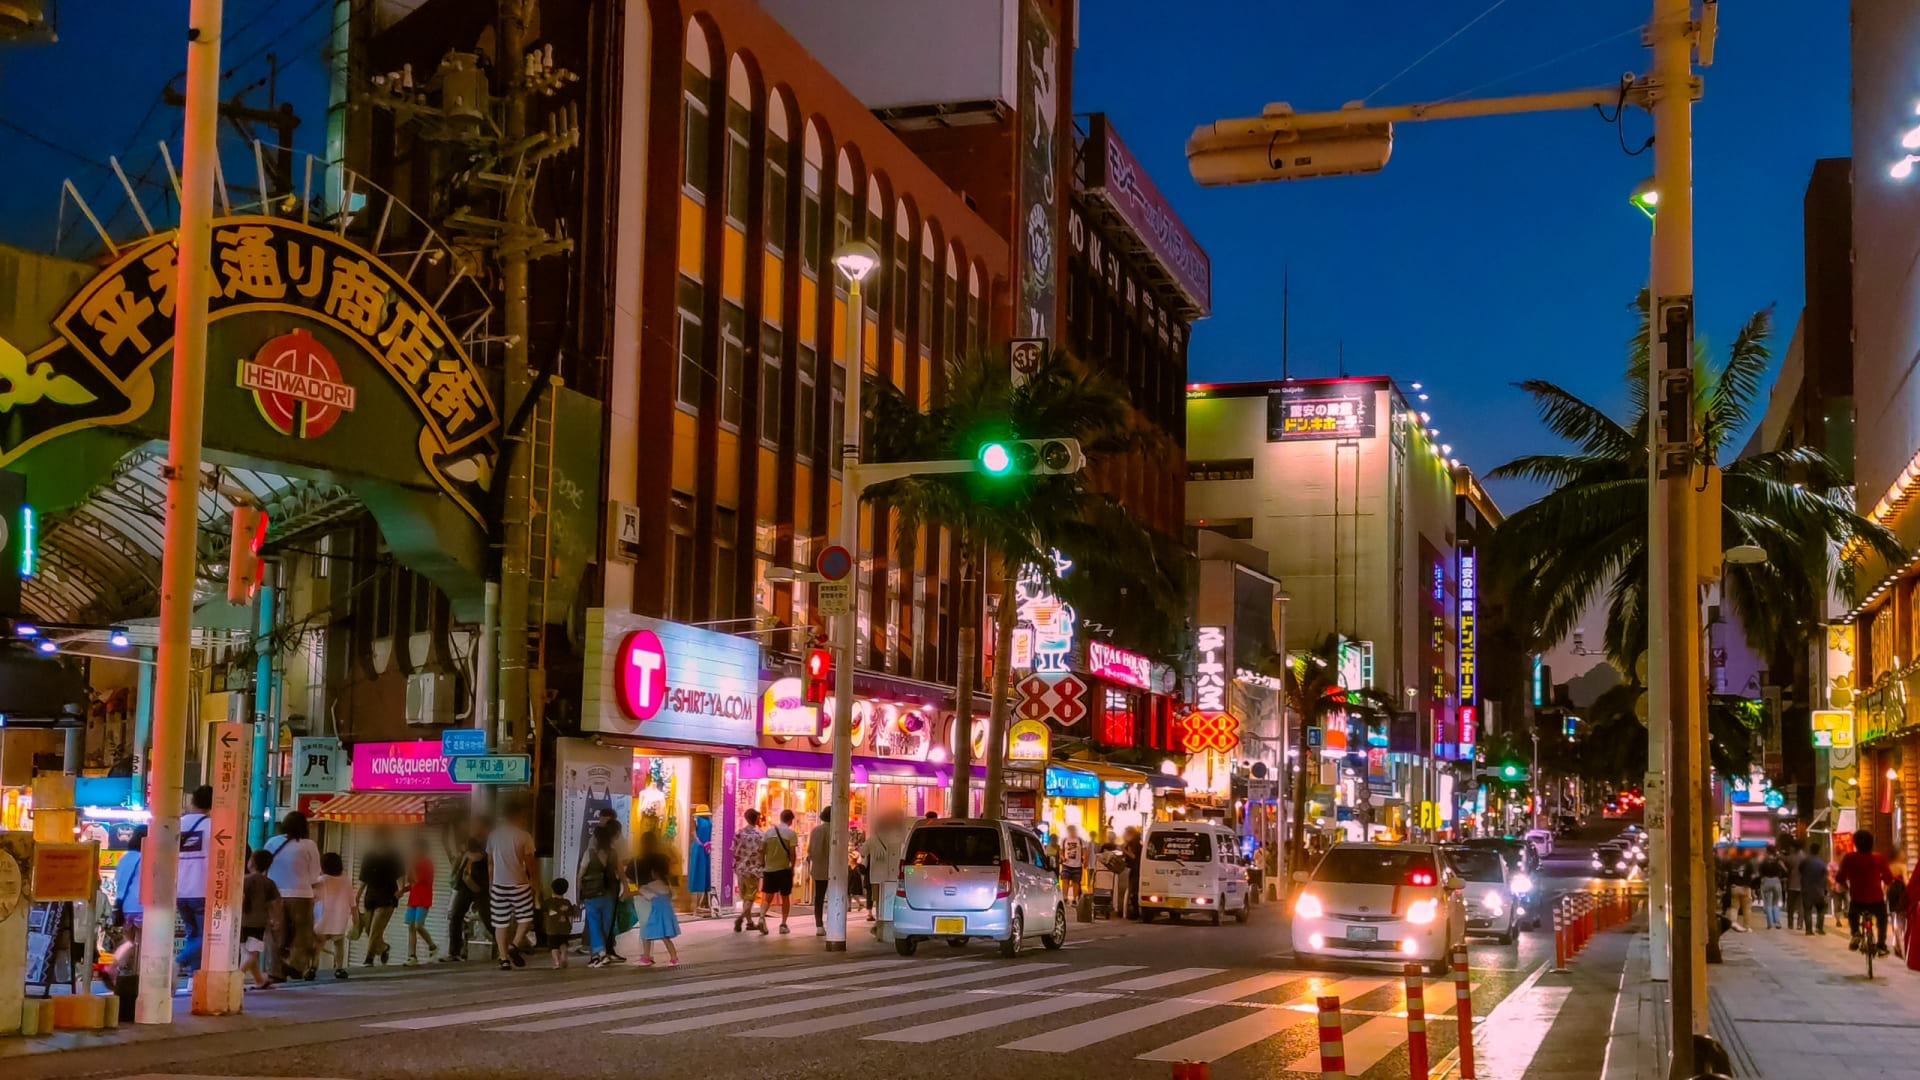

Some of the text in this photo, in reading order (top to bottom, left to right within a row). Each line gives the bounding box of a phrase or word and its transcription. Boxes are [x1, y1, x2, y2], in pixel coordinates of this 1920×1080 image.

[246, 363, 354, 406] HEIWADORI
[632, 648, 661, 708] T
[1090, 642, 1122, 672] STEAK
[1122, 652, 1151, 690] HOUSE
[664, 686, 752, 720] T-SHIRT-YA.COM
[222, 750, 232, 792] 平和通り
[303, 754, 329, 776] 門
[371, 756, 448, 776] KING&queen's
[466, 759, 517, 773] 平和通り
